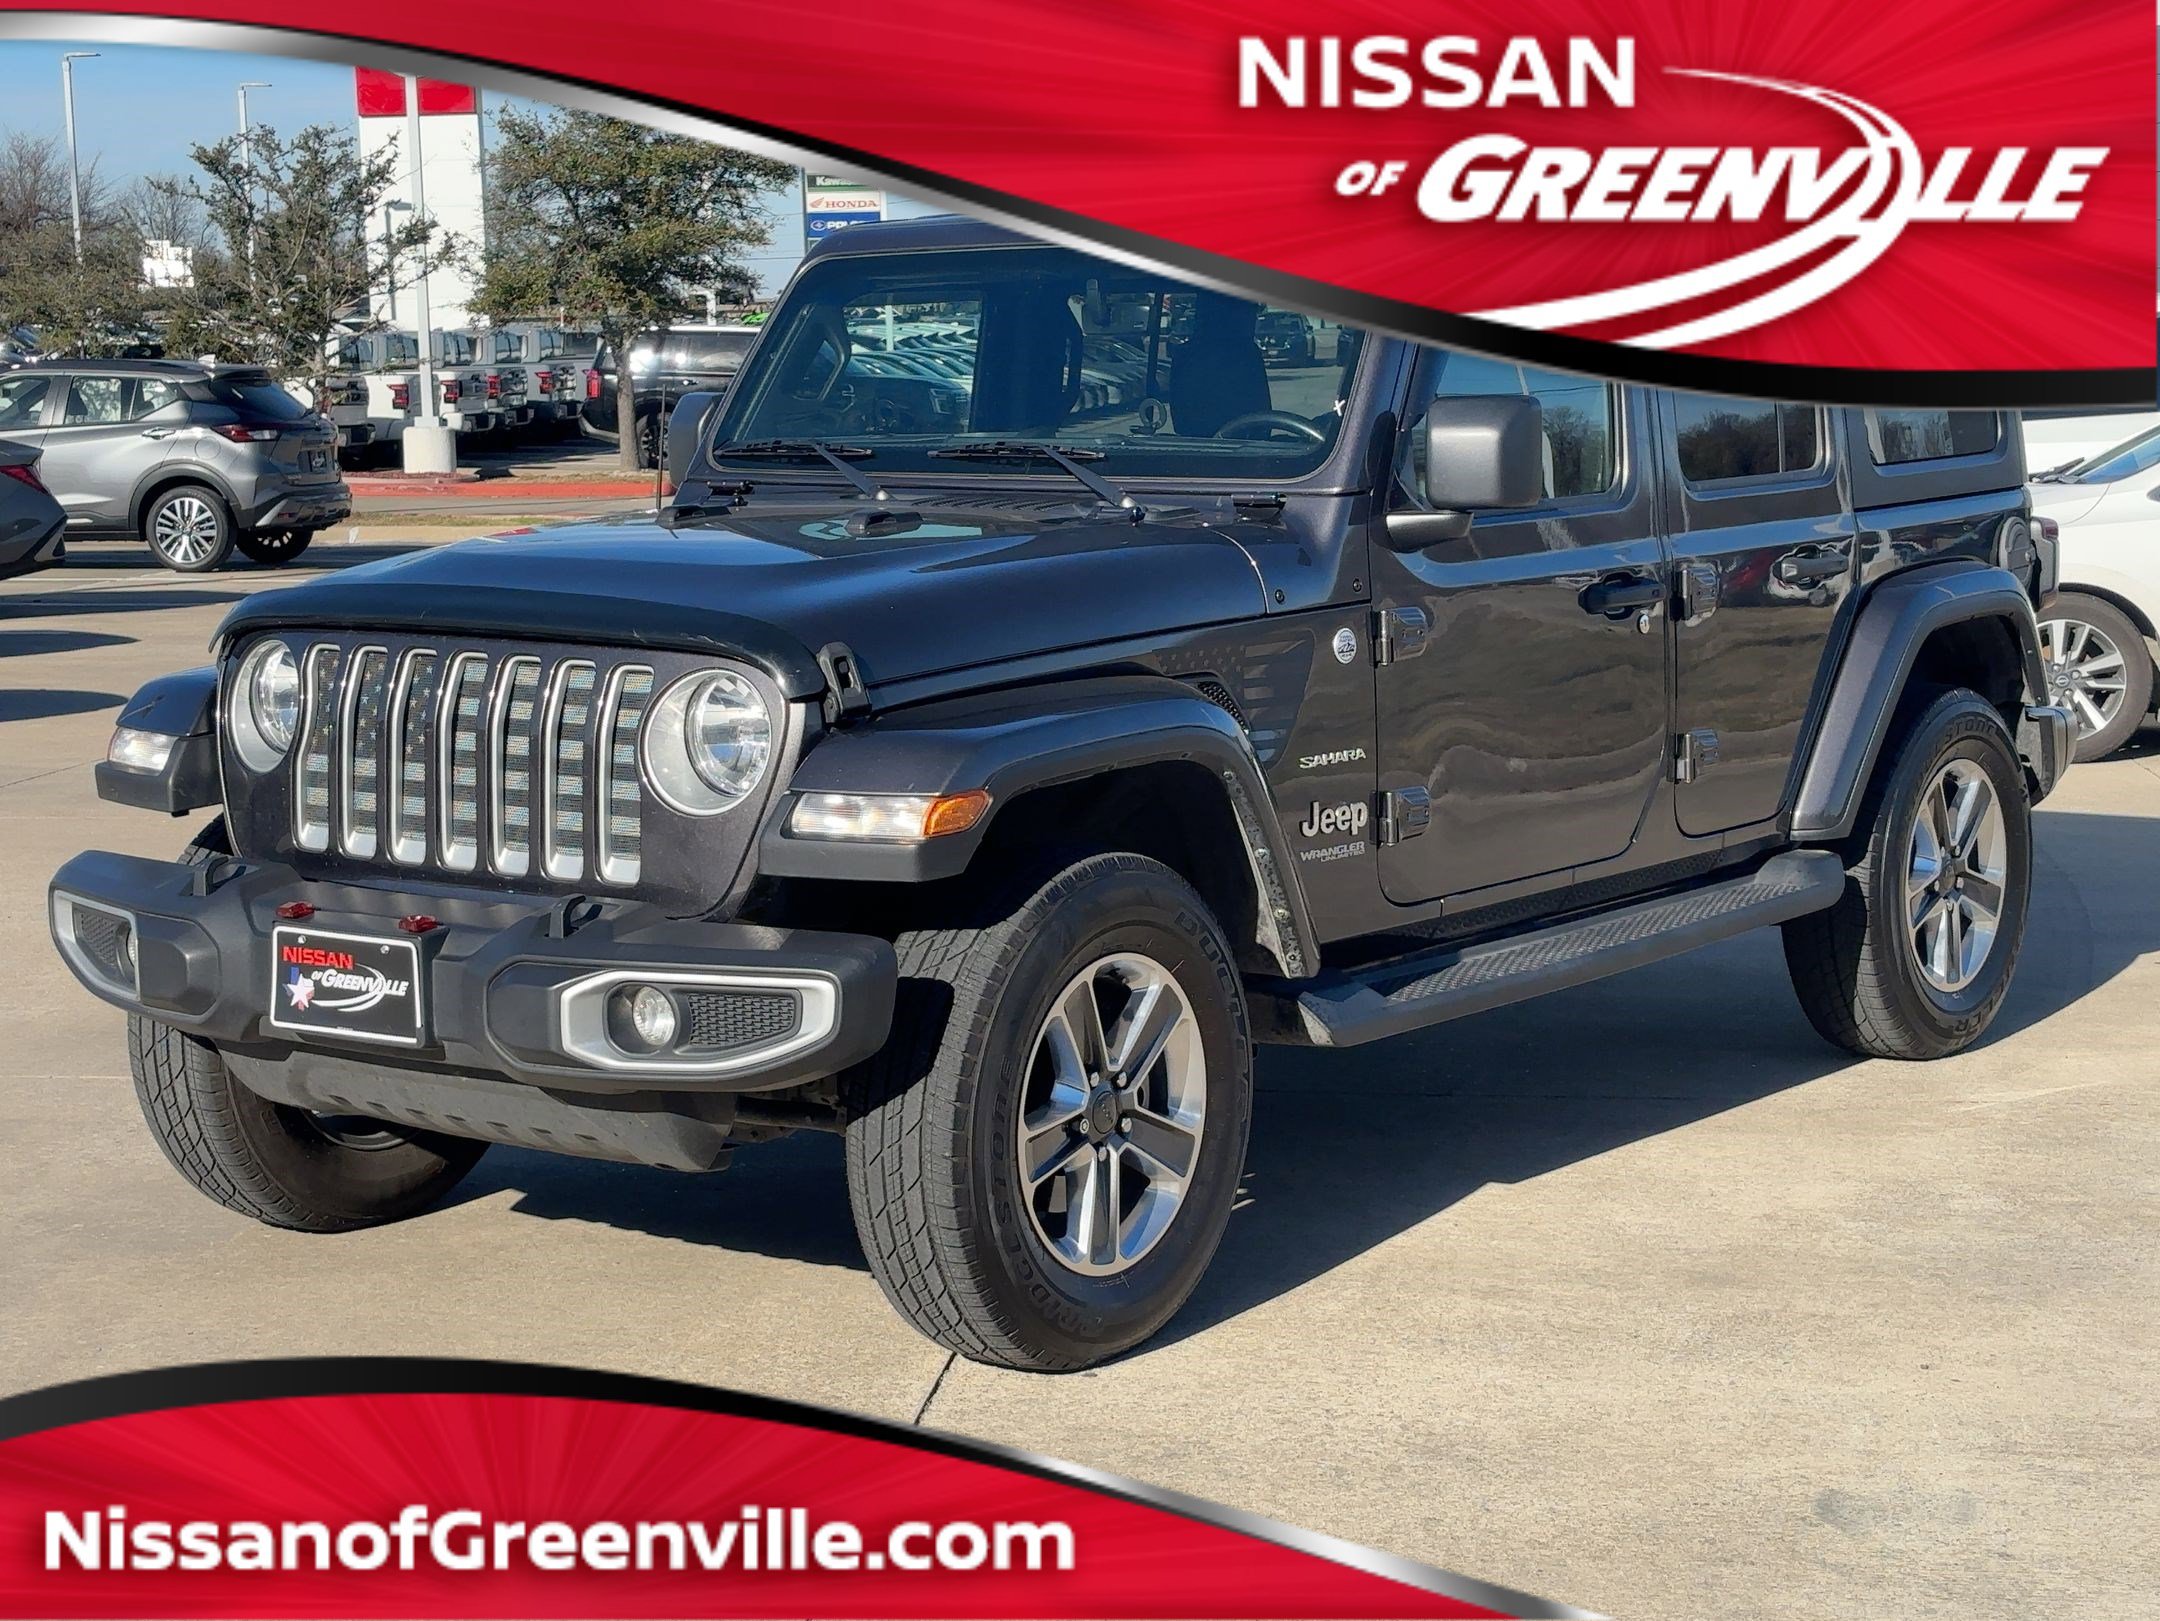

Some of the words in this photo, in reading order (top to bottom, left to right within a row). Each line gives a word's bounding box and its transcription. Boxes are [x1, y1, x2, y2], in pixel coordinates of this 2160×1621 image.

[826, 200, 877, 209] HONDA
[1299, 748, 1367, 769] SAHARA
[1301, 801, 1368, 837] Jeep
[1301, 841, 1365, 861] WRANGLER
[282, 946, 354, 970] NISSAN
[321, 968, 409, 996] GREENVILLE
